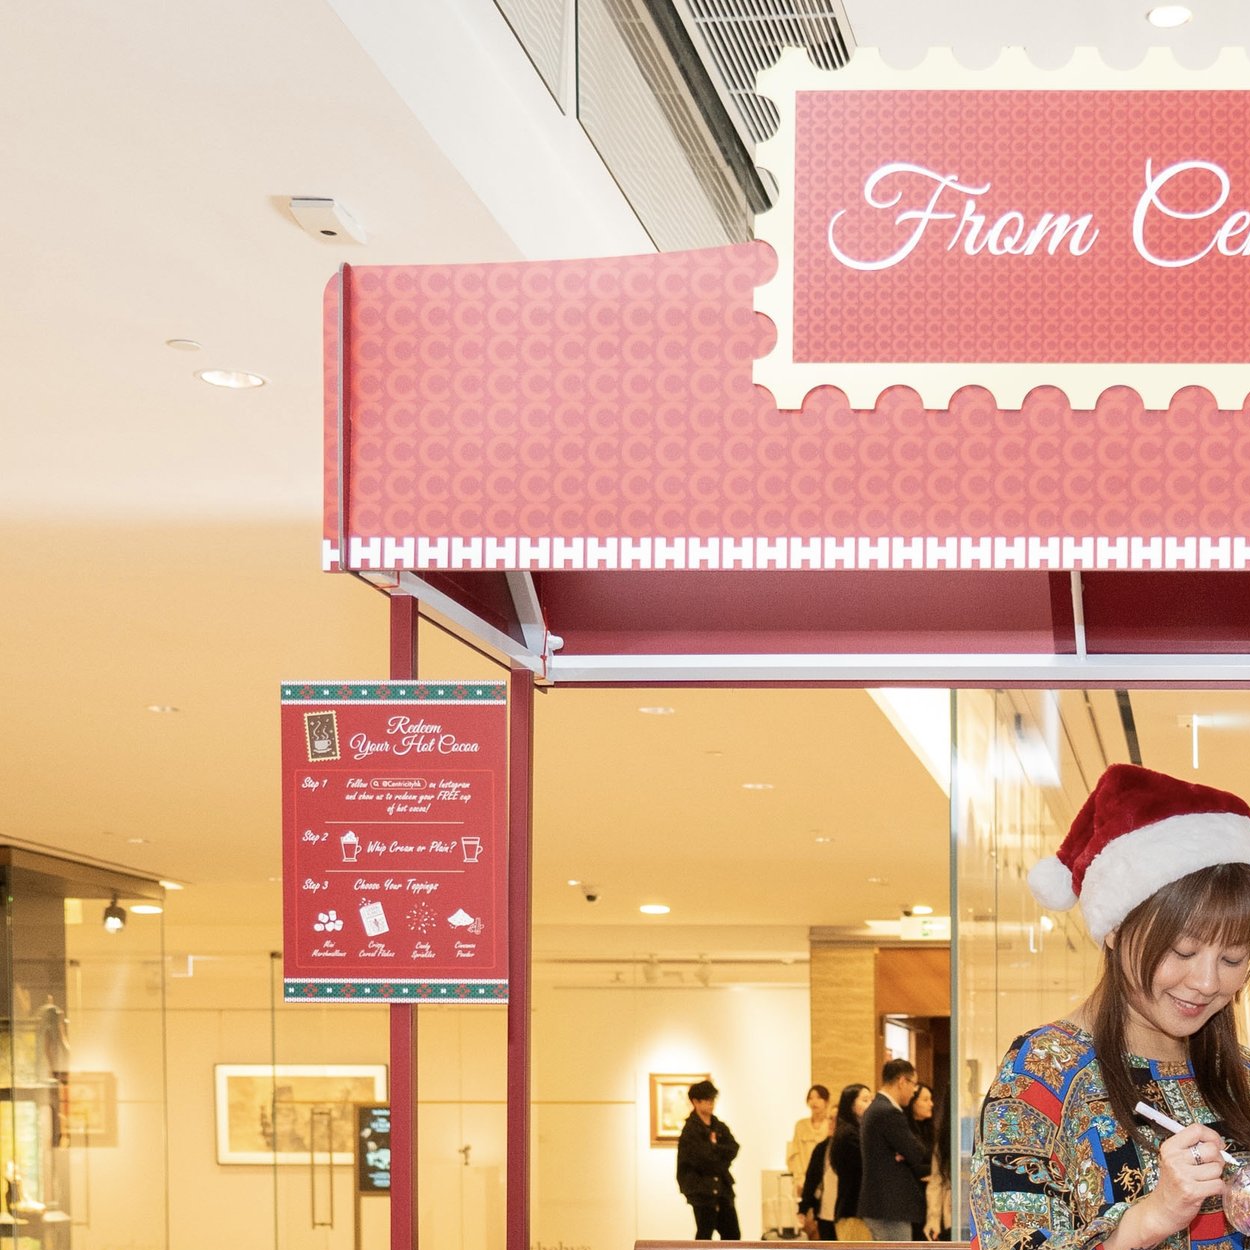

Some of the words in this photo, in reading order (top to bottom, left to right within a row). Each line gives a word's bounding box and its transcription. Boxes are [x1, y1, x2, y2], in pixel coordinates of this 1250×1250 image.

[828, 162, 1099, 271] From
[386, 715, 443, 735] Redeem
[349, 733, 391, 760] Your
[393, 734, 435, 755] Hot
[437, 734, 480, 755] Cocoa
[301, 776, 320, 792] Step
[322, 779, 329, 788] 1
[346, 778, 369, 788] Follow
[438, 779, 471, 791] Instagram
[436, 790, 461, 800] FREE
[302, 829, 320, 846] Step
[321, 832, 329, 841] 2
[366, 841, 386, 856] Whip
[388, 841, 415, 853] Cream
[416, 845, 426, 853] or
[428, 841, 457, 853] Plain?
[302, 878, 321, 894] Step
[323, 880, 329, 890] 3
[353, 878, 381, 890] Choose
[384, 879, 403, 891] Your
[406, 878, 440, 894] Toppings
